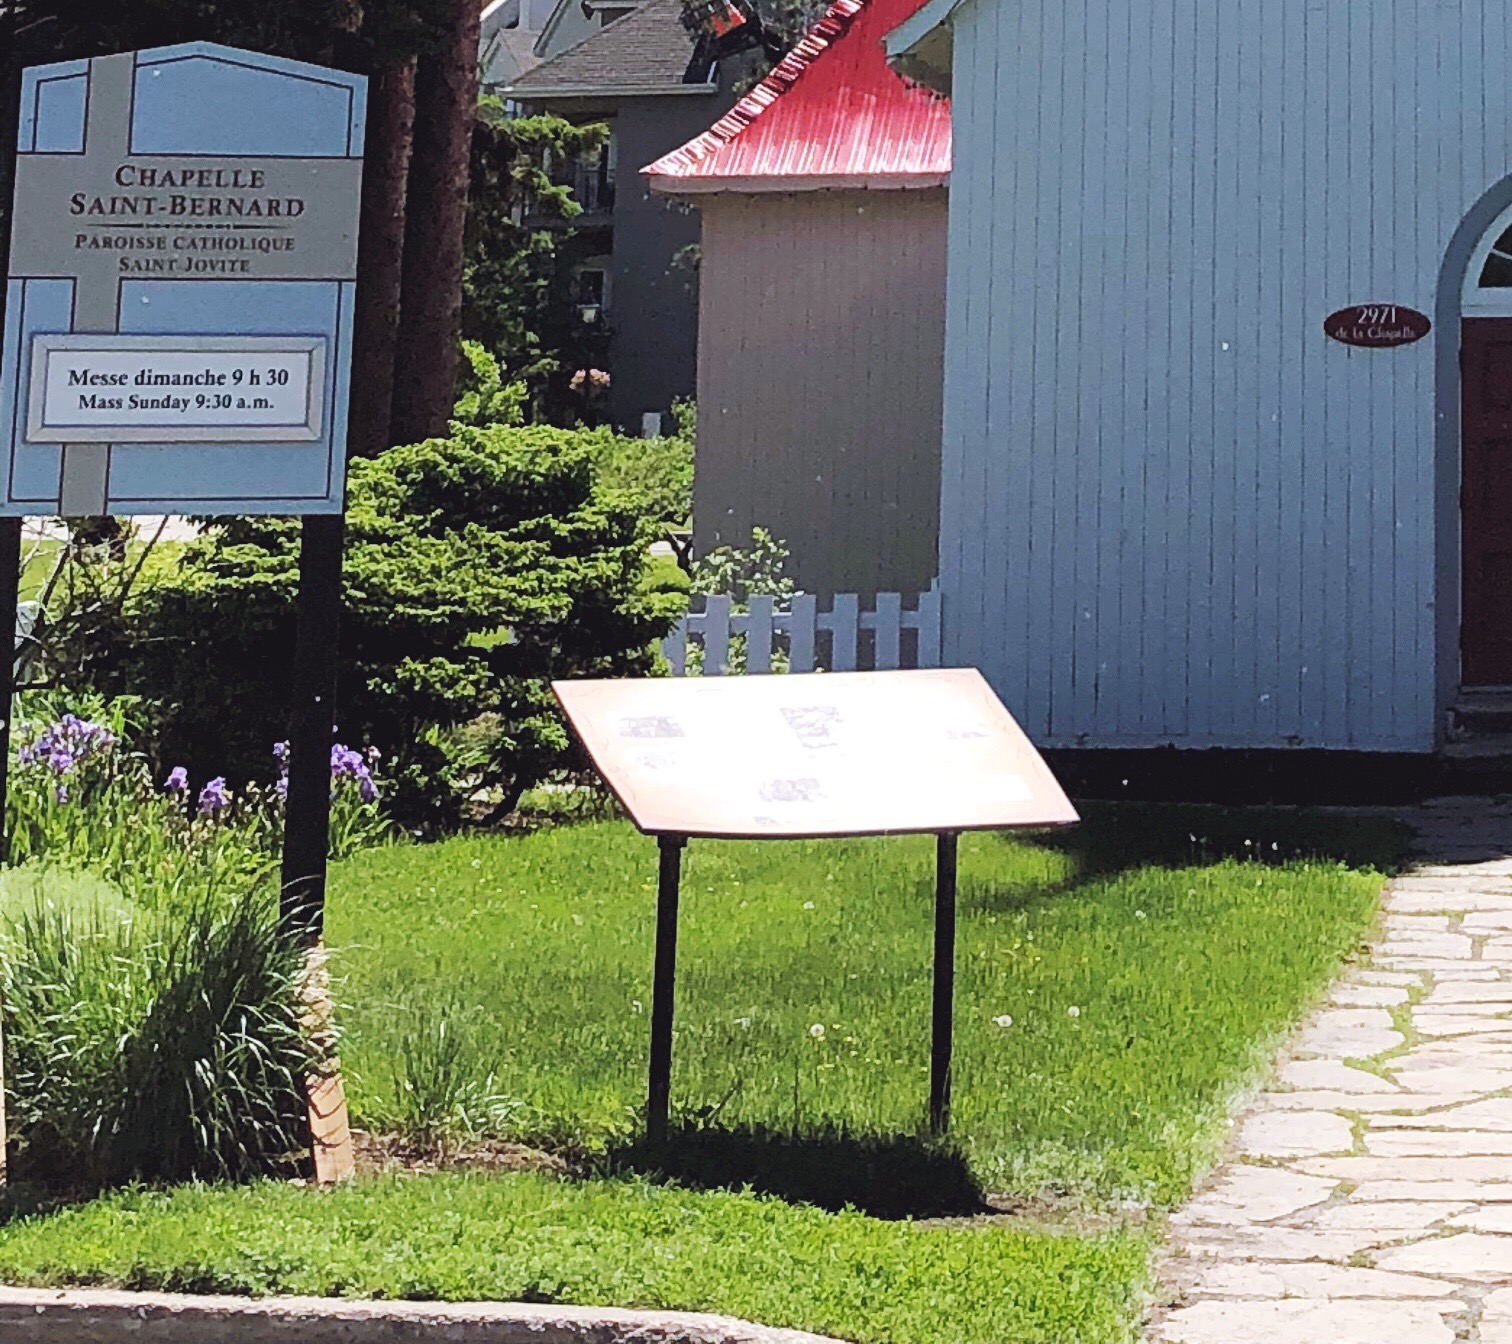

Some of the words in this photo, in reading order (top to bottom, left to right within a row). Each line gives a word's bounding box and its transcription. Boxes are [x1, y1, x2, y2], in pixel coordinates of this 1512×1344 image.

[115, 165, 265, 189] CHAPELLE
[70, 193, 305, 217] SAINT-BERNARD
[75, 234, 167, 250] PAROISSE
[173, 236, 295, 254] CATHOLIQUE
[119, 256, 178, 272] SAINT
[184, 256, 250, 273] JOVITE
[1358, 307, 1396, 324] 2971
[68, 368, 129, 387] Messe
[134, 368, 227, 386] dimanche
[232, 368, 244, 386] 9
[249, 368, 261, 386] h
[266, 368, 289, 386] 30
[79, 394, 123, 410] Mass
[128, 394, 191, 413] Sunday
[195, 394, 233, 409] 9:30
[236, 397, 275, 409] a.m.
